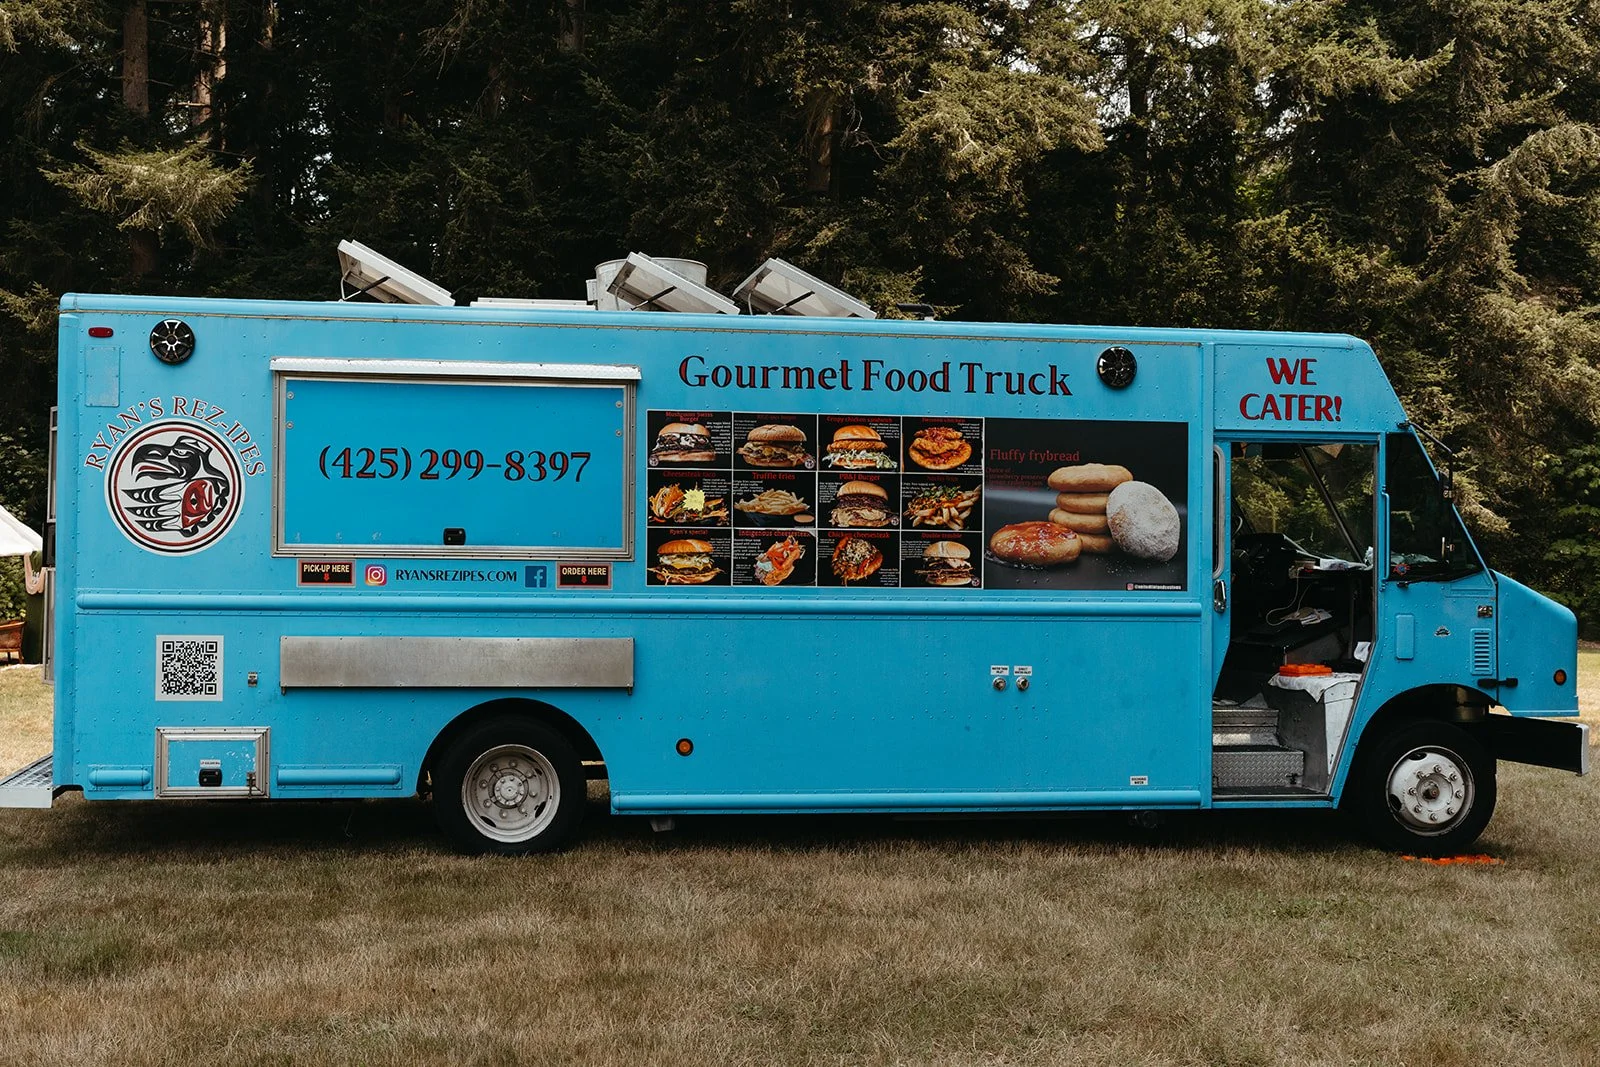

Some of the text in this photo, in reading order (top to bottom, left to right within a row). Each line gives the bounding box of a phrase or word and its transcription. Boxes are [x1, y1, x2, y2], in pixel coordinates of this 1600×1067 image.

[678, 355, 1073, 396] Gourmet Food Truck
[1266, 357, 1317, 385] WE
[1239, 393, 1342, 421] CATER!
[85, 396, 266, 477] RYAN'S REZ-IPES
[319, 445, 591, 482] (425) 299-8397
[990, 448, 1080, 464] Fluffy frybread
[303, 564, 350, 573] PICK-UP HERE
[395, 569, 517, 582] RYANSREZIPES.COM
[562, 567, 607, 576] ORDER HERE
